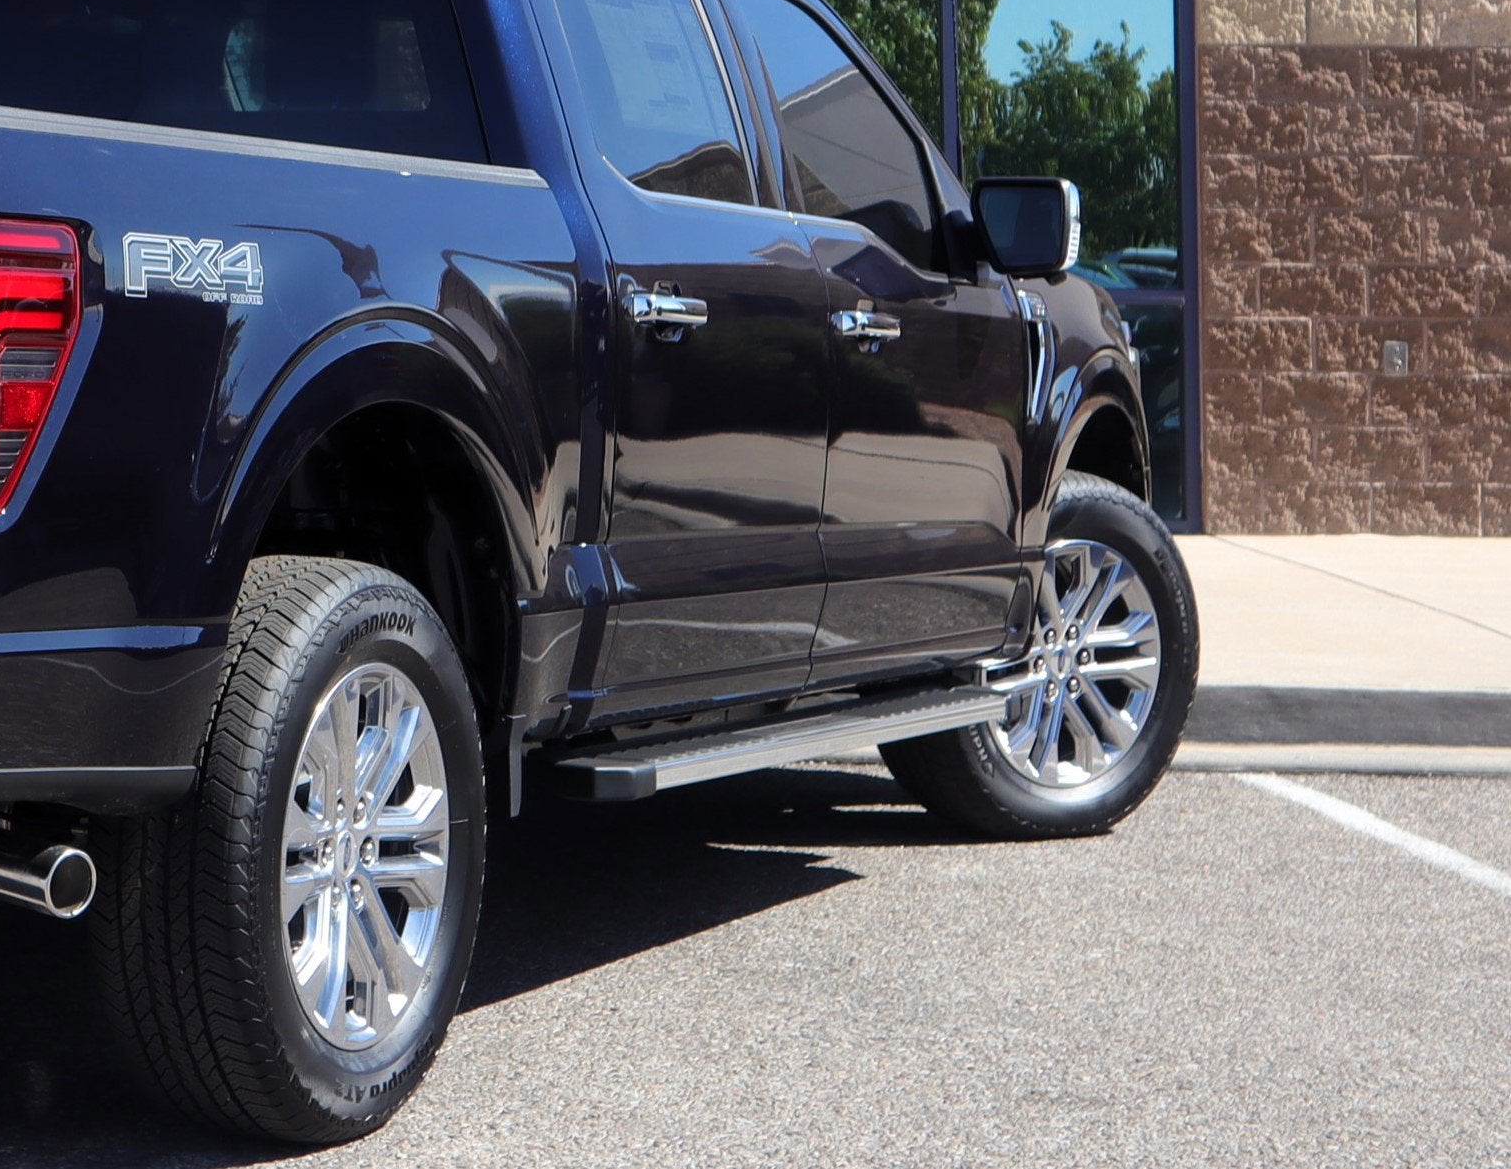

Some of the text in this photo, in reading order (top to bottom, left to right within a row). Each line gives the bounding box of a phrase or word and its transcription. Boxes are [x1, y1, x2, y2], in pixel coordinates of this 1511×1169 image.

[122, 232, 264, 297] FX4
[202, 292, 264, 305] OFF ROAD
